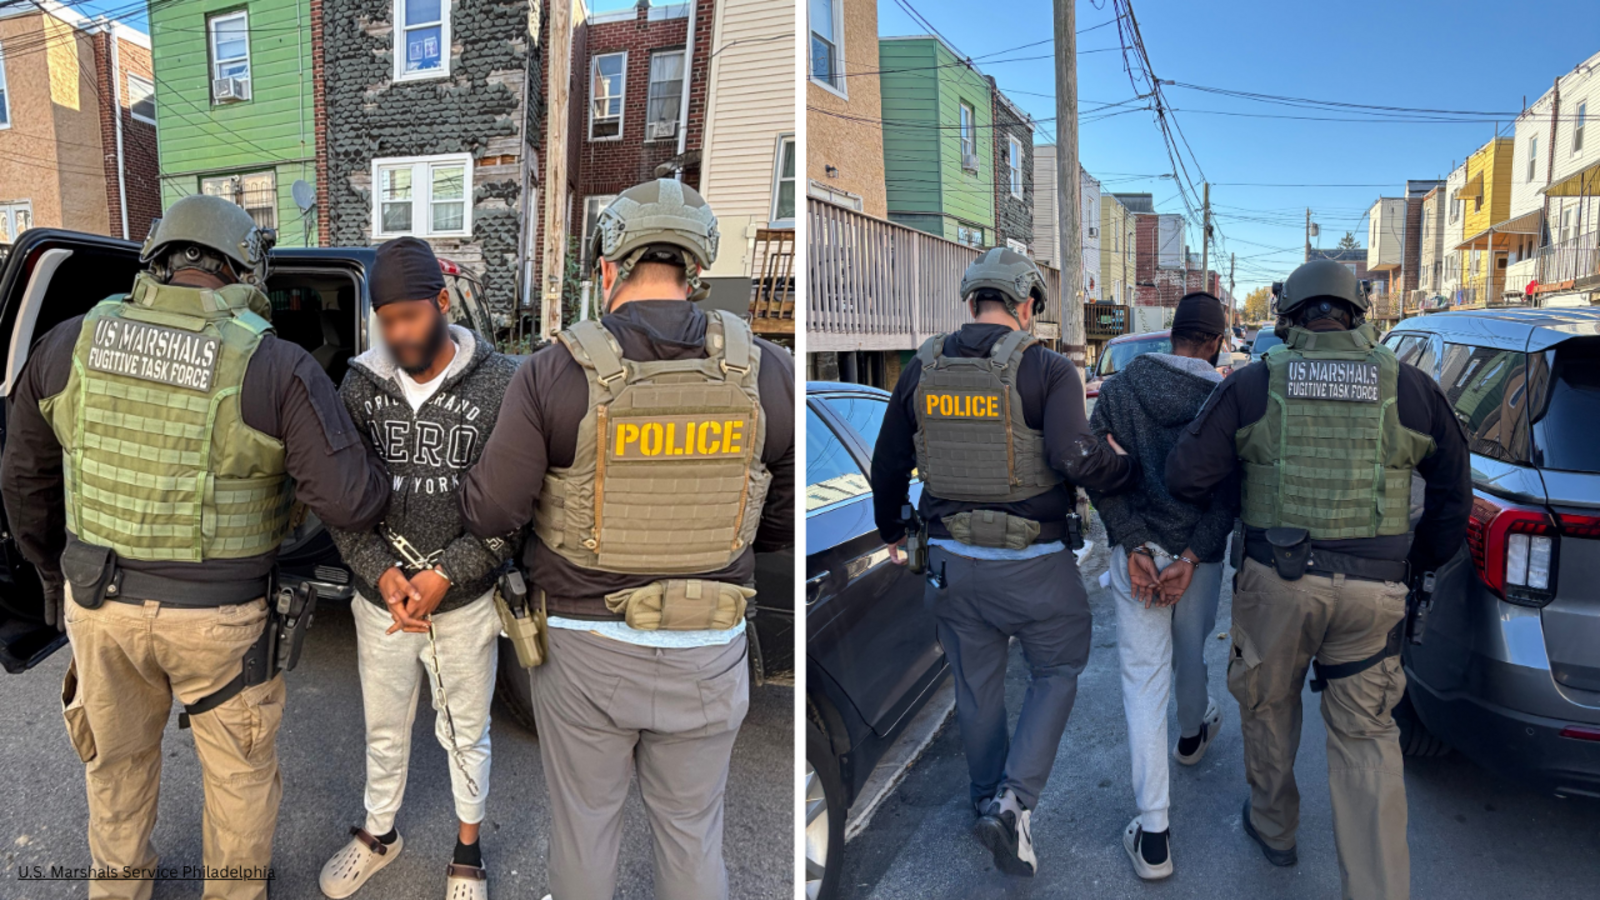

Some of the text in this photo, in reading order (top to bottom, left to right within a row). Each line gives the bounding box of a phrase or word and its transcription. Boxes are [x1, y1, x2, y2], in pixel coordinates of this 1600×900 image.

[95, 319, 215, 367] US MARSHALS
[88, 347, 210, 389] FUGITIVE TASK FORCE
[1289, 362, 1378, 384] US MARSHALS
[1288, 382, 1378, 401] FUGITIVE TASK FORCE
[428, 392, 480, 421] RAND
[925, 394, 999, 418] POLICE
[615, 420, 744, 457] POLICE
[414, 473, 460, 494] YORK
